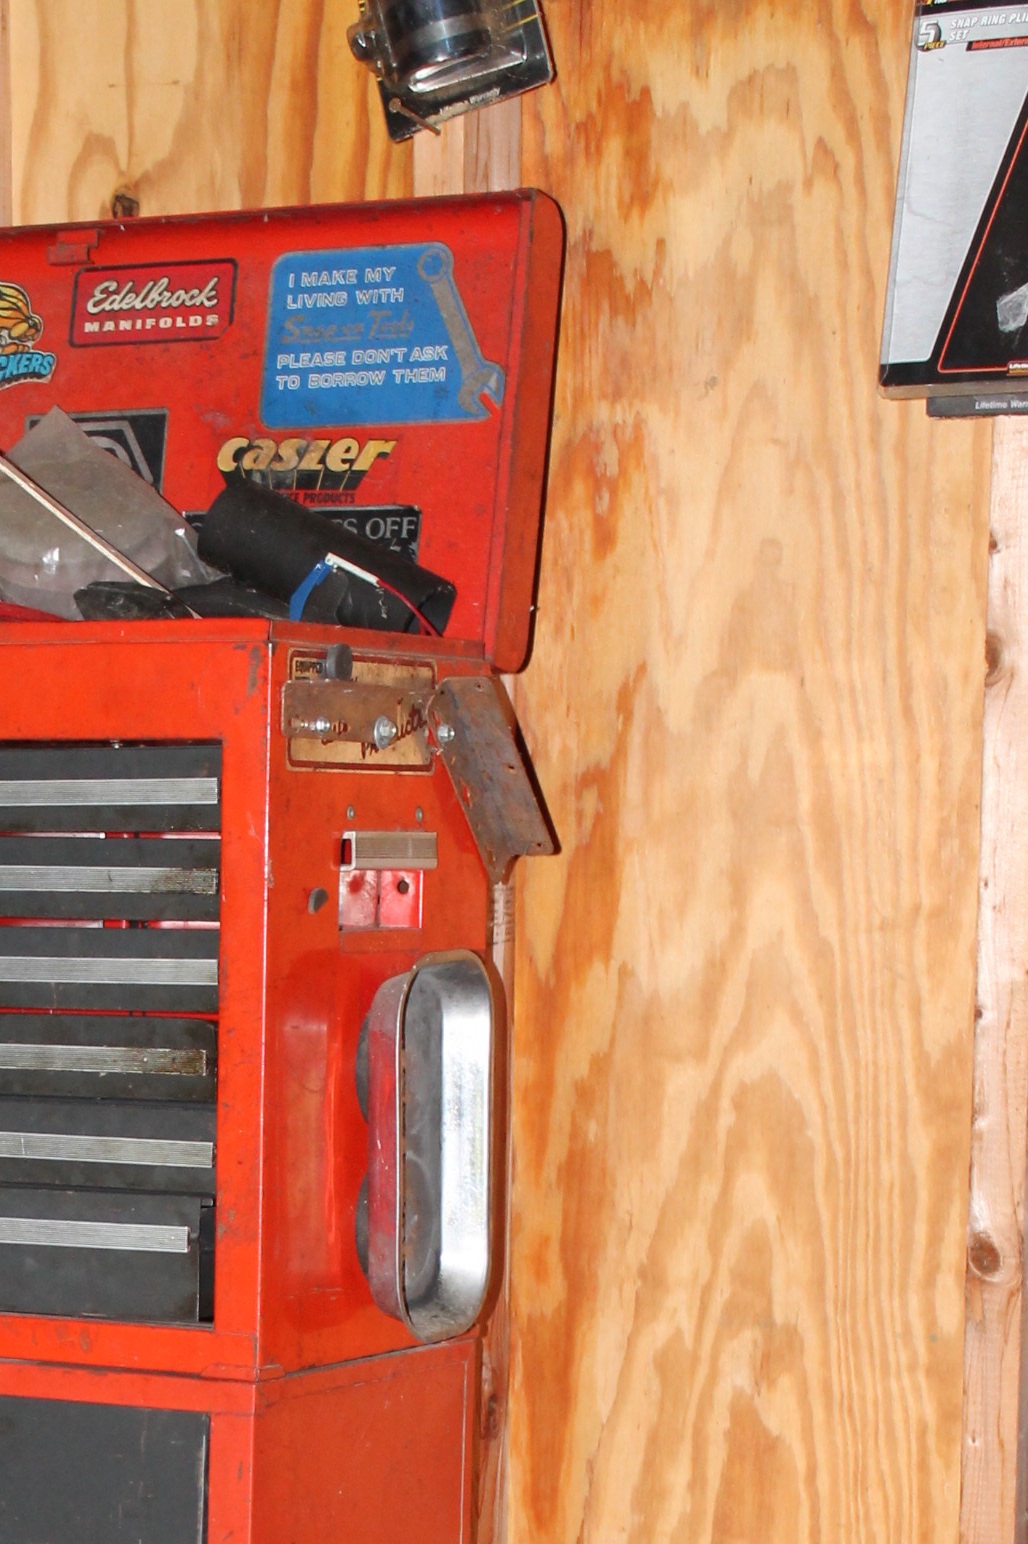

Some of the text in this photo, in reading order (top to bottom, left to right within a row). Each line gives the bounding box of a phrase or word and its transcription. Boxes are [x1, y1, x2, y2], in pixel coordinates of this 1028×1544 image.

[951, 17, 978, 29] SNAP
[980, 14, 1006, 26] RING
[917, 19, 938, 47] 5
[949, 30, 969, 41] SET
[288, 266, 397, 288] I MAKE MY
[87, 277, 219, 314] Edelbrock
[286, 288, 404, 309] LIVING WITH
[84, 314, 219, 333] MANIFOLDS
[277, 345, 449, 369] PLEASE DON'T ASK
[275, 366, 446, 390] TO BORROW THEM
[975, 401, 1008, 410] Lifetime
[303, 491, 355, 504] PRODUCTS
[365, 516, 417, 540] OFF
